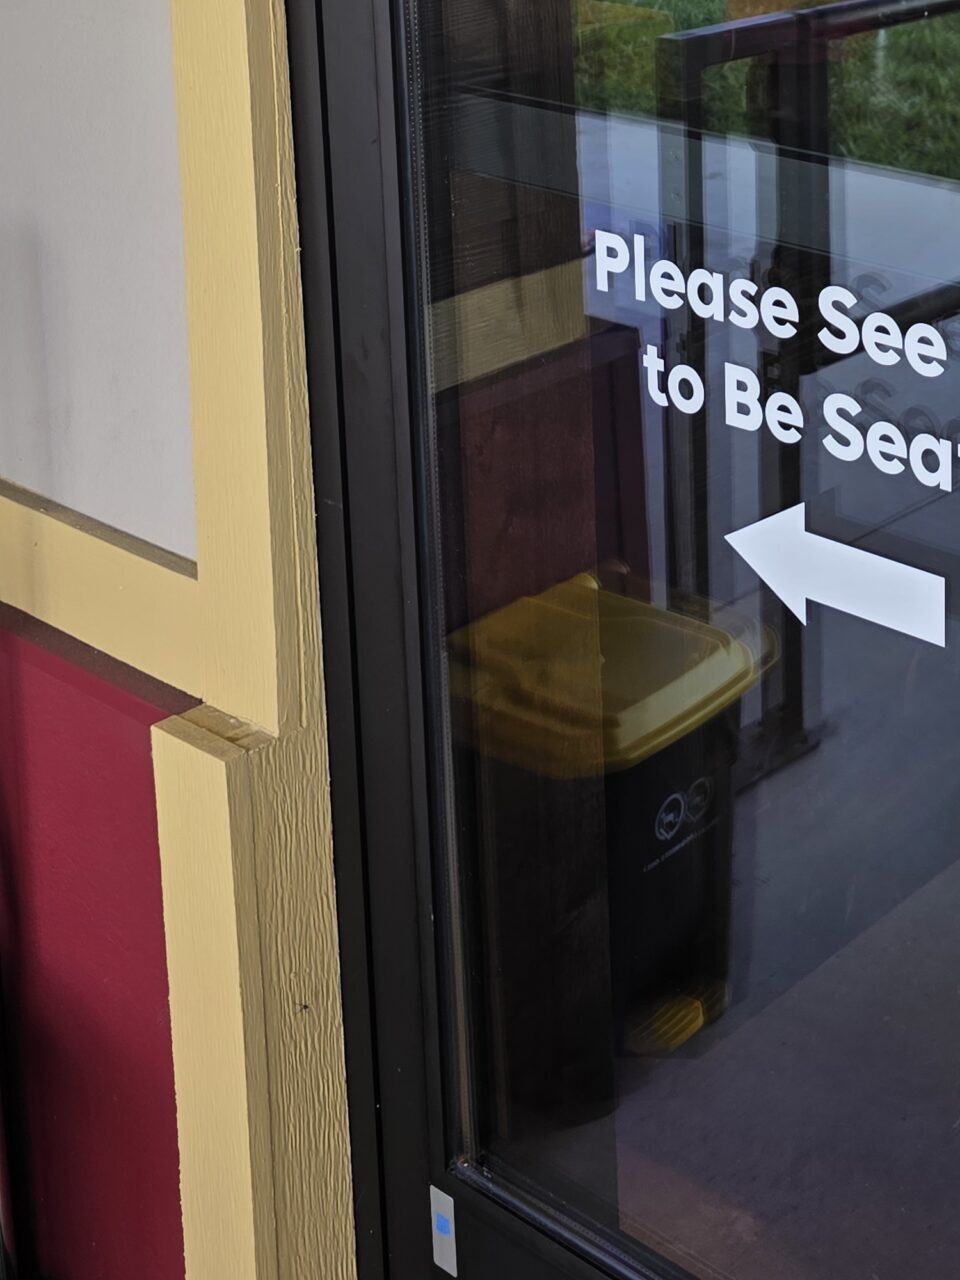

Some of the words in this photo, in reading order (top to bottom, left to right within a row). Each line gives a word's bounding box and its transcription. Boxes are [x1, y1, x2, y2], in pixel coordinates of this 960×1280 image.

[594, 228, 800, 339] Please
[817, 285, 948, 378] See
[642, 344, 705, 414] to
[724, 361, 804, 445] Be
